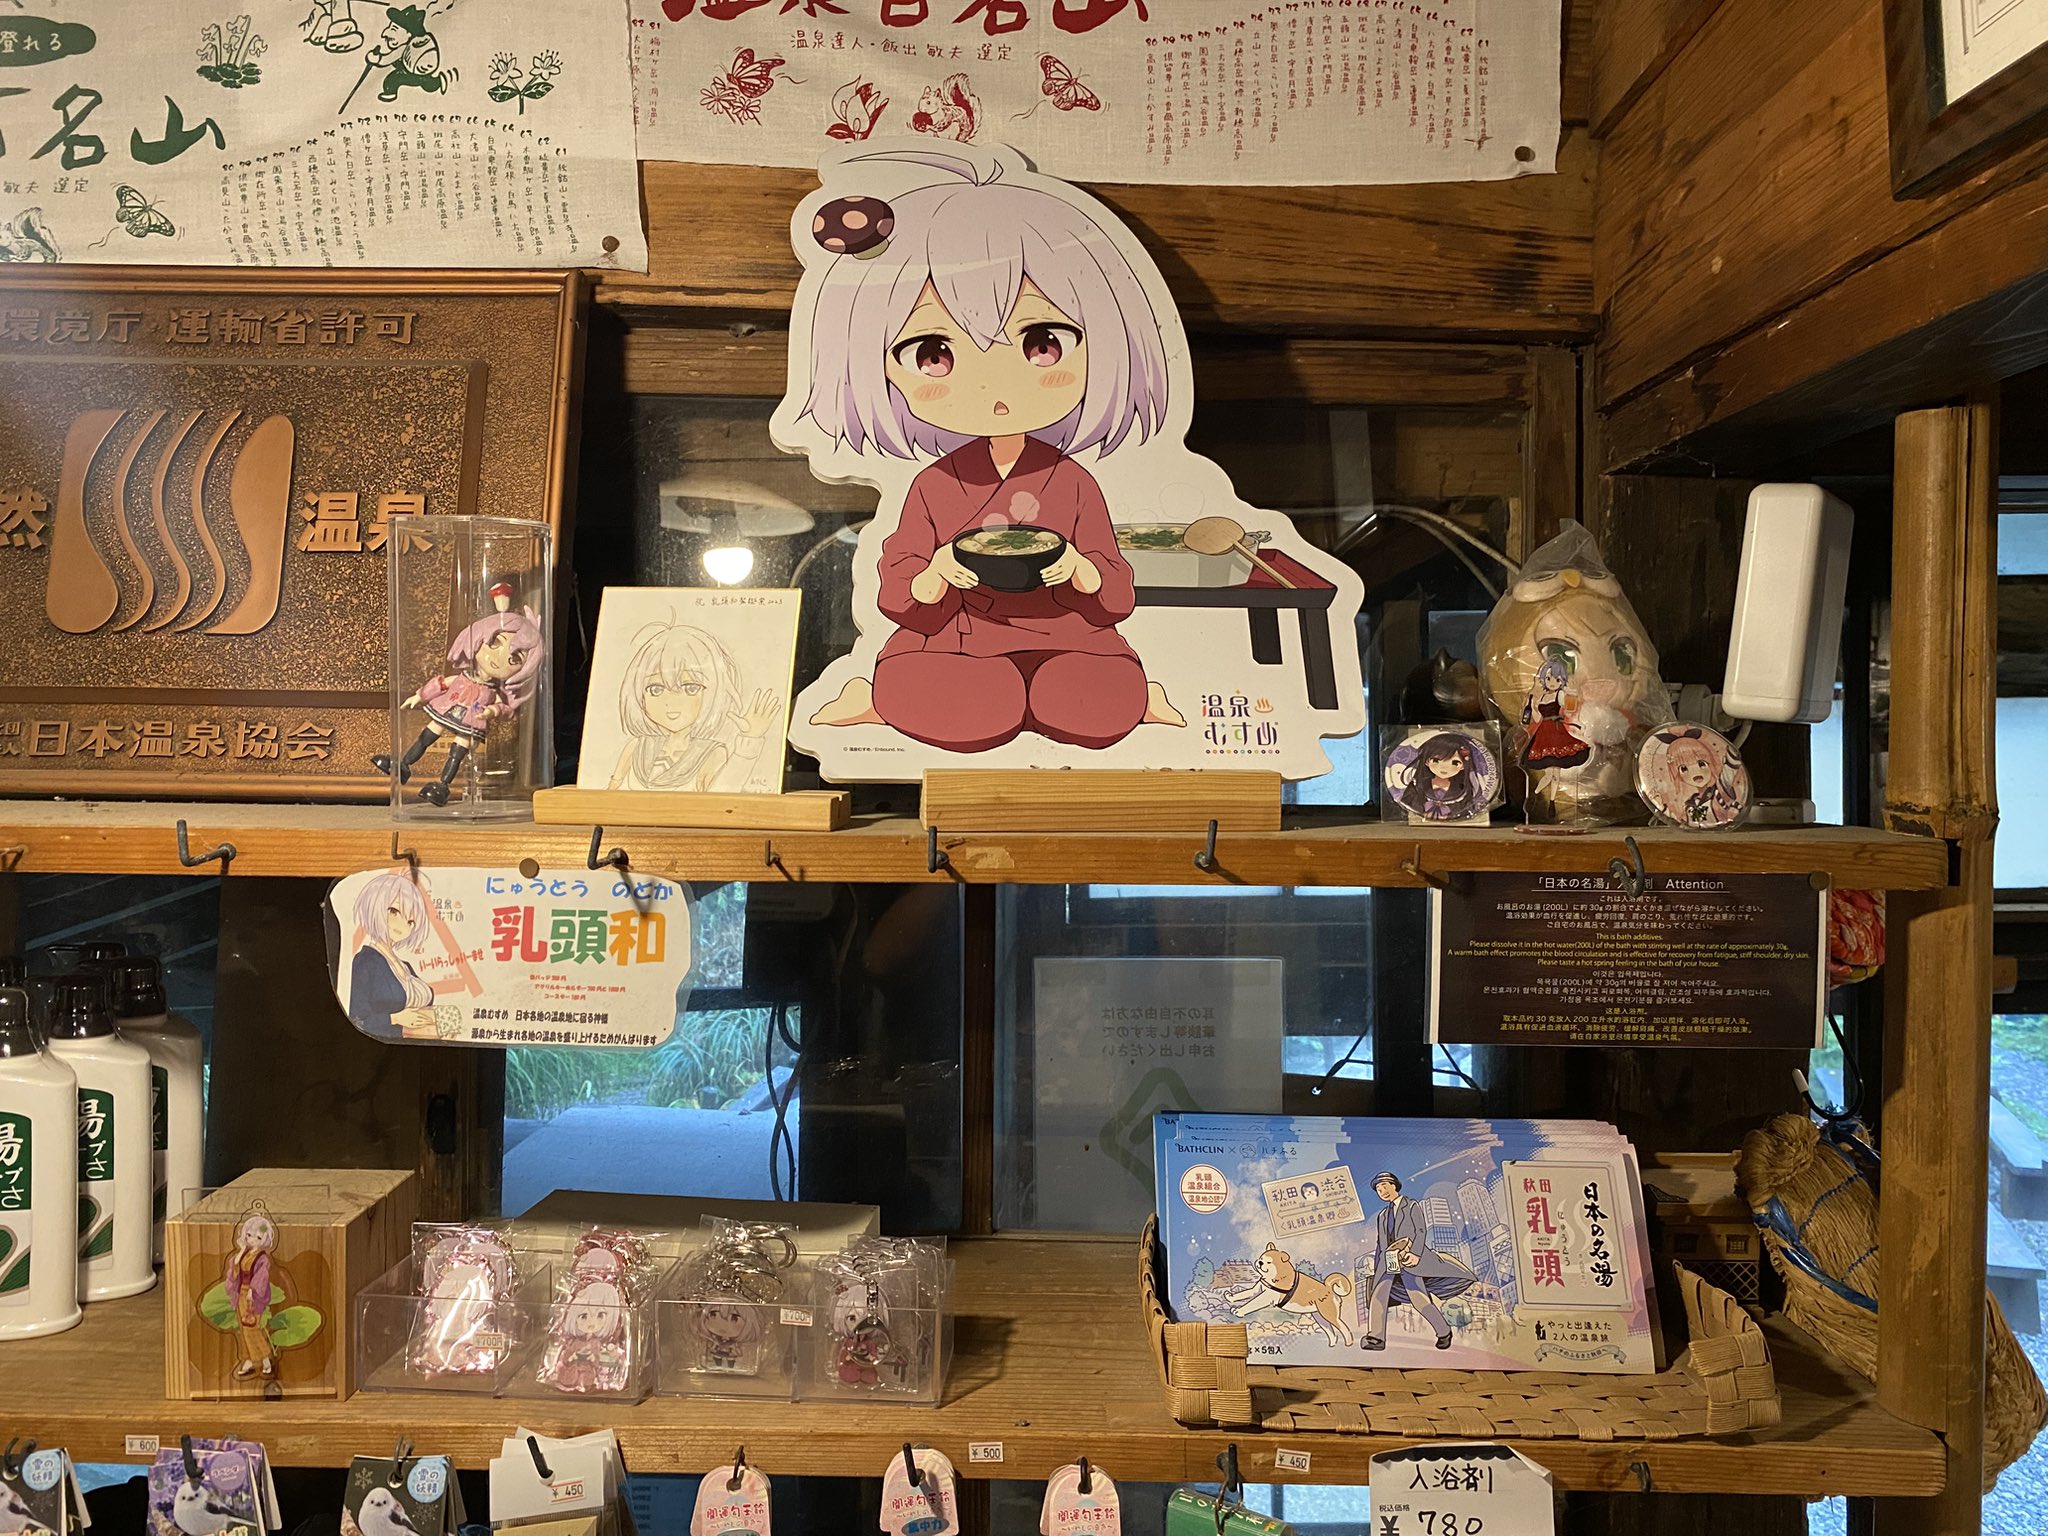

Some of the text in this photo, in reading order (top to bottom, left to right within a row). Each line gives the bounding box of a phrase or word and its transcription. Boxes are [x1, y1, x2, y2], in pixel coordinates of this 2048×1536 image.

[976, 43, 1013, 62] 選定
[0, 83, 226, 171] 名山
[3, 177, 89, 194] 敏夫 選定
[0, 488, 435, 554] 然 温泉
[1201, 689, 1251, 718] 温泉
[28, 719, 335, 760] 日本温泉協会
[1204, 721, 1278, 746] むすめ
[485, 876, 589, 898] にゅうとう
[1538, 876, 1724, 889] 「日本の名湯」剤 Attention
[433, 898, 452, 910] 温泉
[491, 905, 666, 966] 乳頭和
[473, 1007, 609, 1025] 温泉むすめ 日本各地の温泉地に宿る神様
[1175, 1143, 1297, 1156] BATHCLIN ハチふる
[1187, 1181, 1221, 1191] 温泉組合
[1195, 1173, 1213, 1182] 乳頭
[1523, 1177, 1552, 1194] 秋田
[1271, 1175, 1347, 1203] 秋田 渋谷
[1280, 1200, 1297, 1208] AKITA
[1325, 1189, 1348, 1198] SHIBUYA
[1286, 1210, 1336, 1230] 乳頭温泉郷
[1557, 1210, 1571, 1267] にゅうとう
[1583, 1181, 1618, 1288] 日本の名湯
[1553, 1332, 1609, 1343] 2人の温泉旅
[140, 1440, 157, 1452] 600
[983, 1448, 1001, 1459] 500
[32, 1458, 53, 1471] 雪の
[1290, 1456, 1308, 1470] 450
[32, 1471, 53, 1482] 妖精
[418, 1467, 439, 1481] 雪の
[1409, 1463, 1493, 1494] 入浴剤
[416, 1482, 438, 1494] 妖精
[565, 1484, 584, 1496] 450
[1379, 1504, 1410, 1513] 税込価格
[1380, 1510, 1483, 1536] ¥ 780
